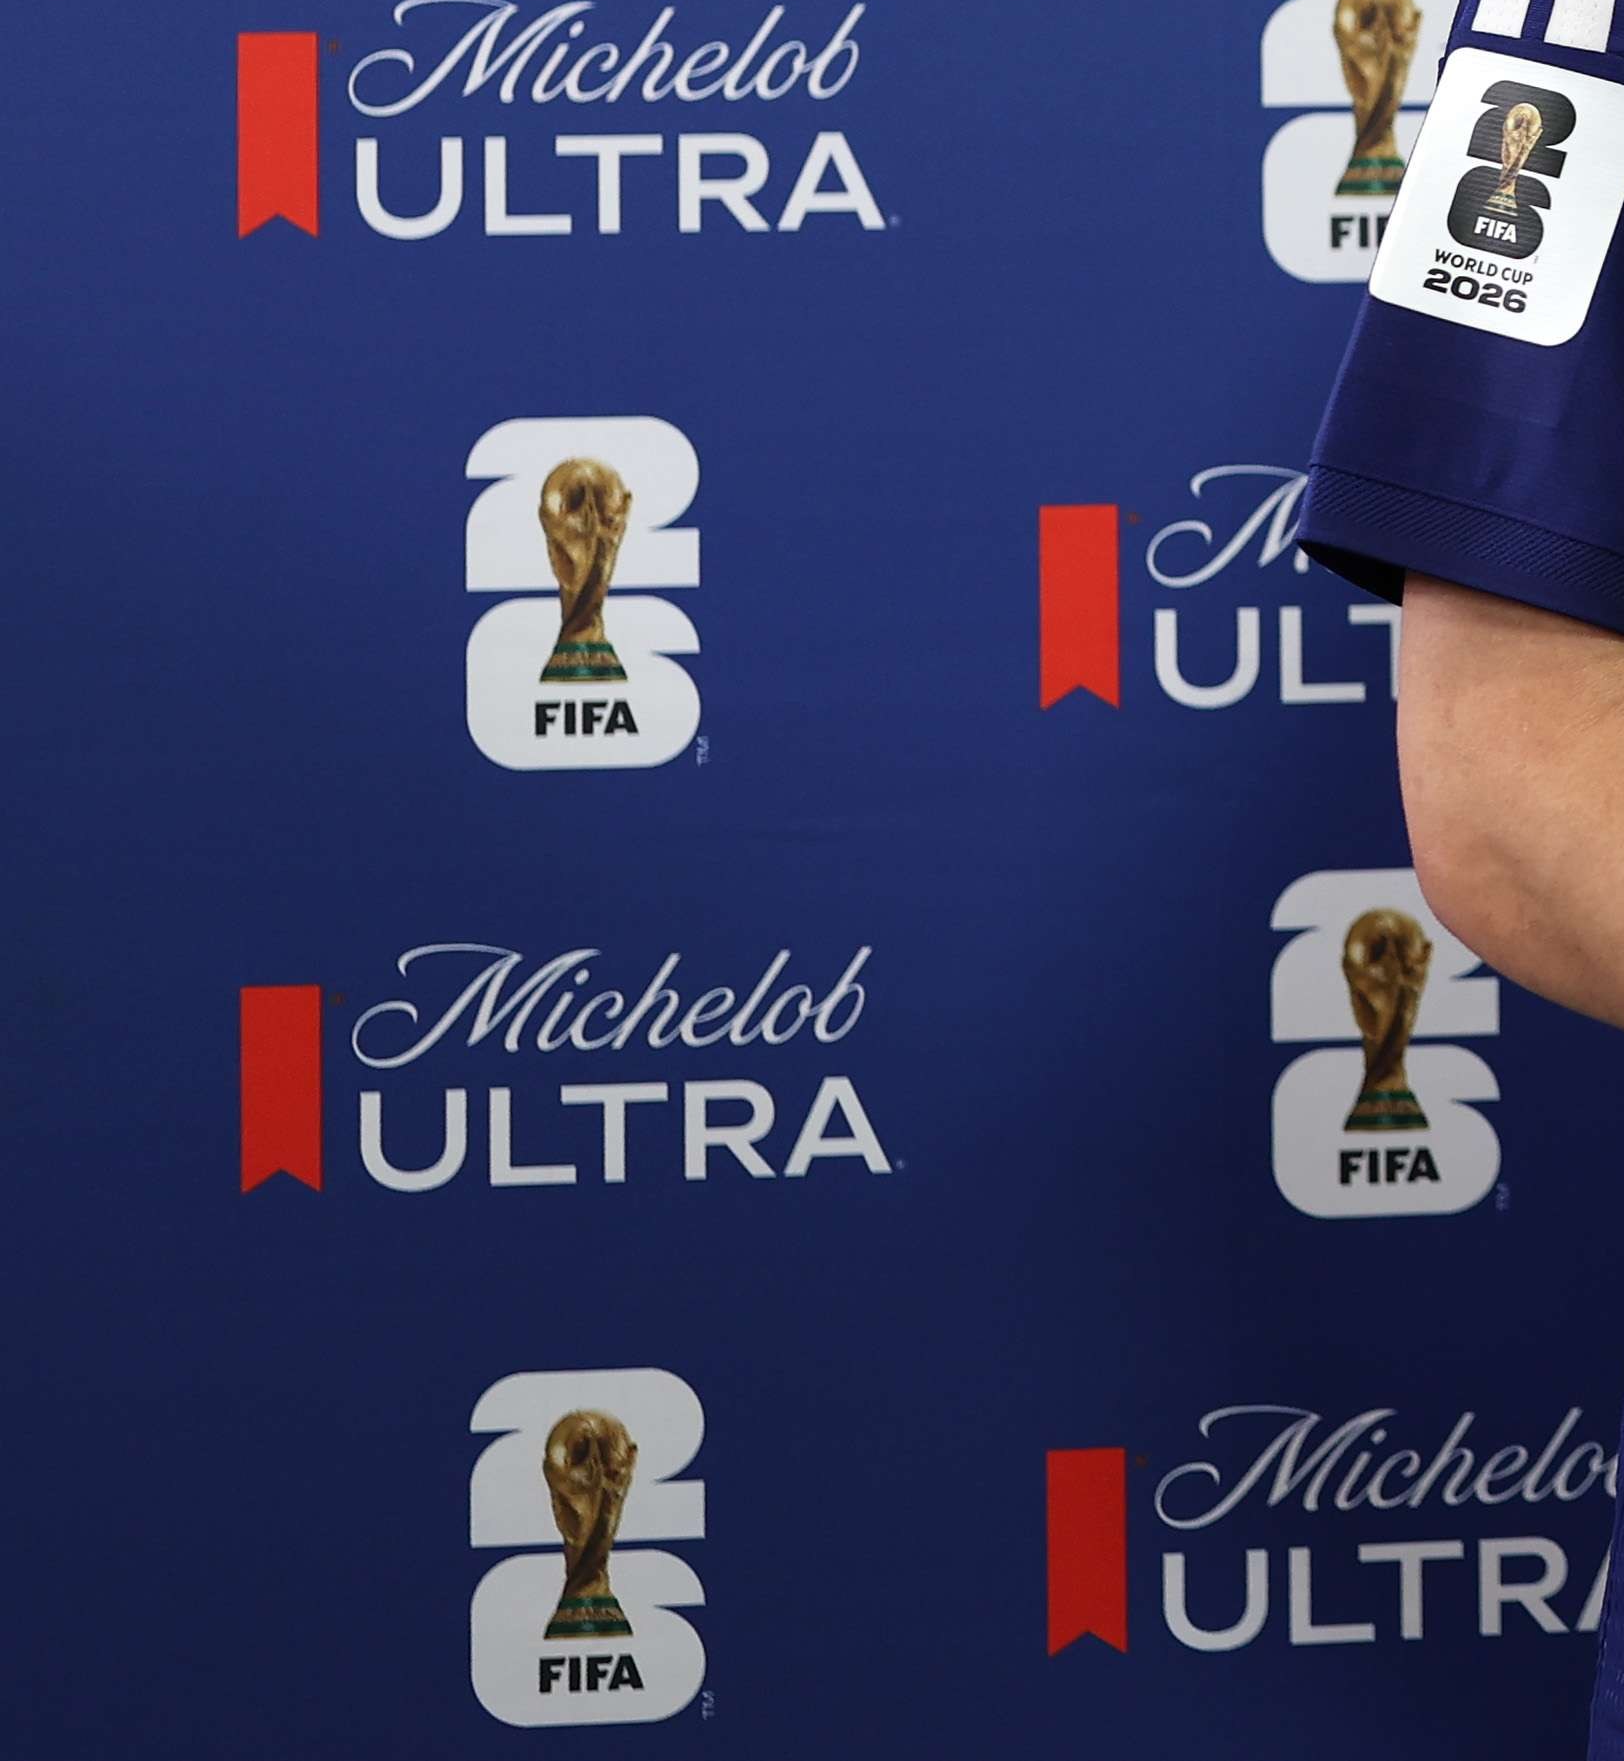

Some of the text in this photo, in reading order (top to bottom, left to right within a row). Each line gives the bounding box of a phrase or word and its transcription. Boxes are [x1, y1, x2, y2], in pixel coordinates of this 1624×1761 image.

[356, 132, 885, 239] ULTRA
[1473, 215, 1518, 244] FIFA
[1433, 248, 1534, 286] WORLD CUP
[1422, 267, 1527, 314] 2026
[535, 701, 638, 736] FIFA
[352, 944, 871, 1068] Michelob
[360, 1077, 891, 1191] ULTRA
[1340, 1148, 1440, 1185] FIFA
[1154, 1405, 1618, 1529] Michelo
[539, 1655, 643, 1693] FIFA
